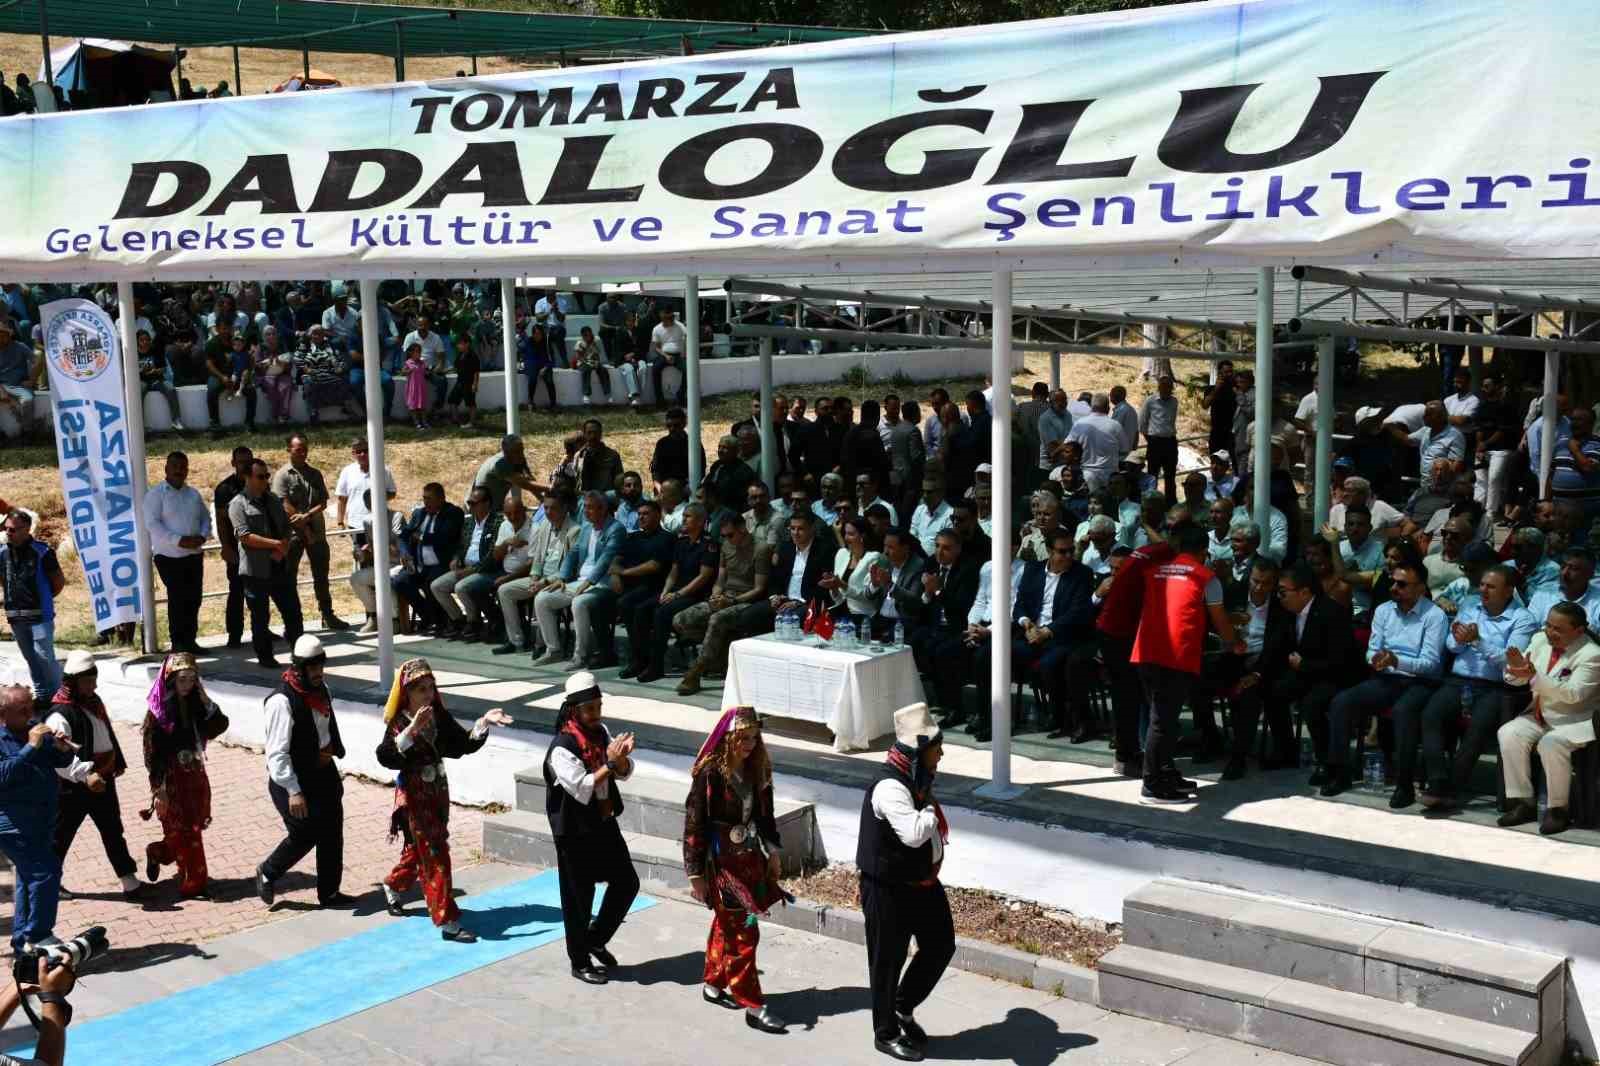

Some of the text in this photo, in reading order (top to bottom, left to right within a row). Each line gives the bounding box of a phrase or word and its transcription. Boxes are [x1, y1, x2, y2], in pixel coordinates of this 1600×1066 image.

[112, 71, 1389, 220] DADALOĞLU
[410, 67, 800, 134] TOMARZA
[46, 158, 1600, 253] Geleneksel Kültür ve Sanat Şenlikleri
